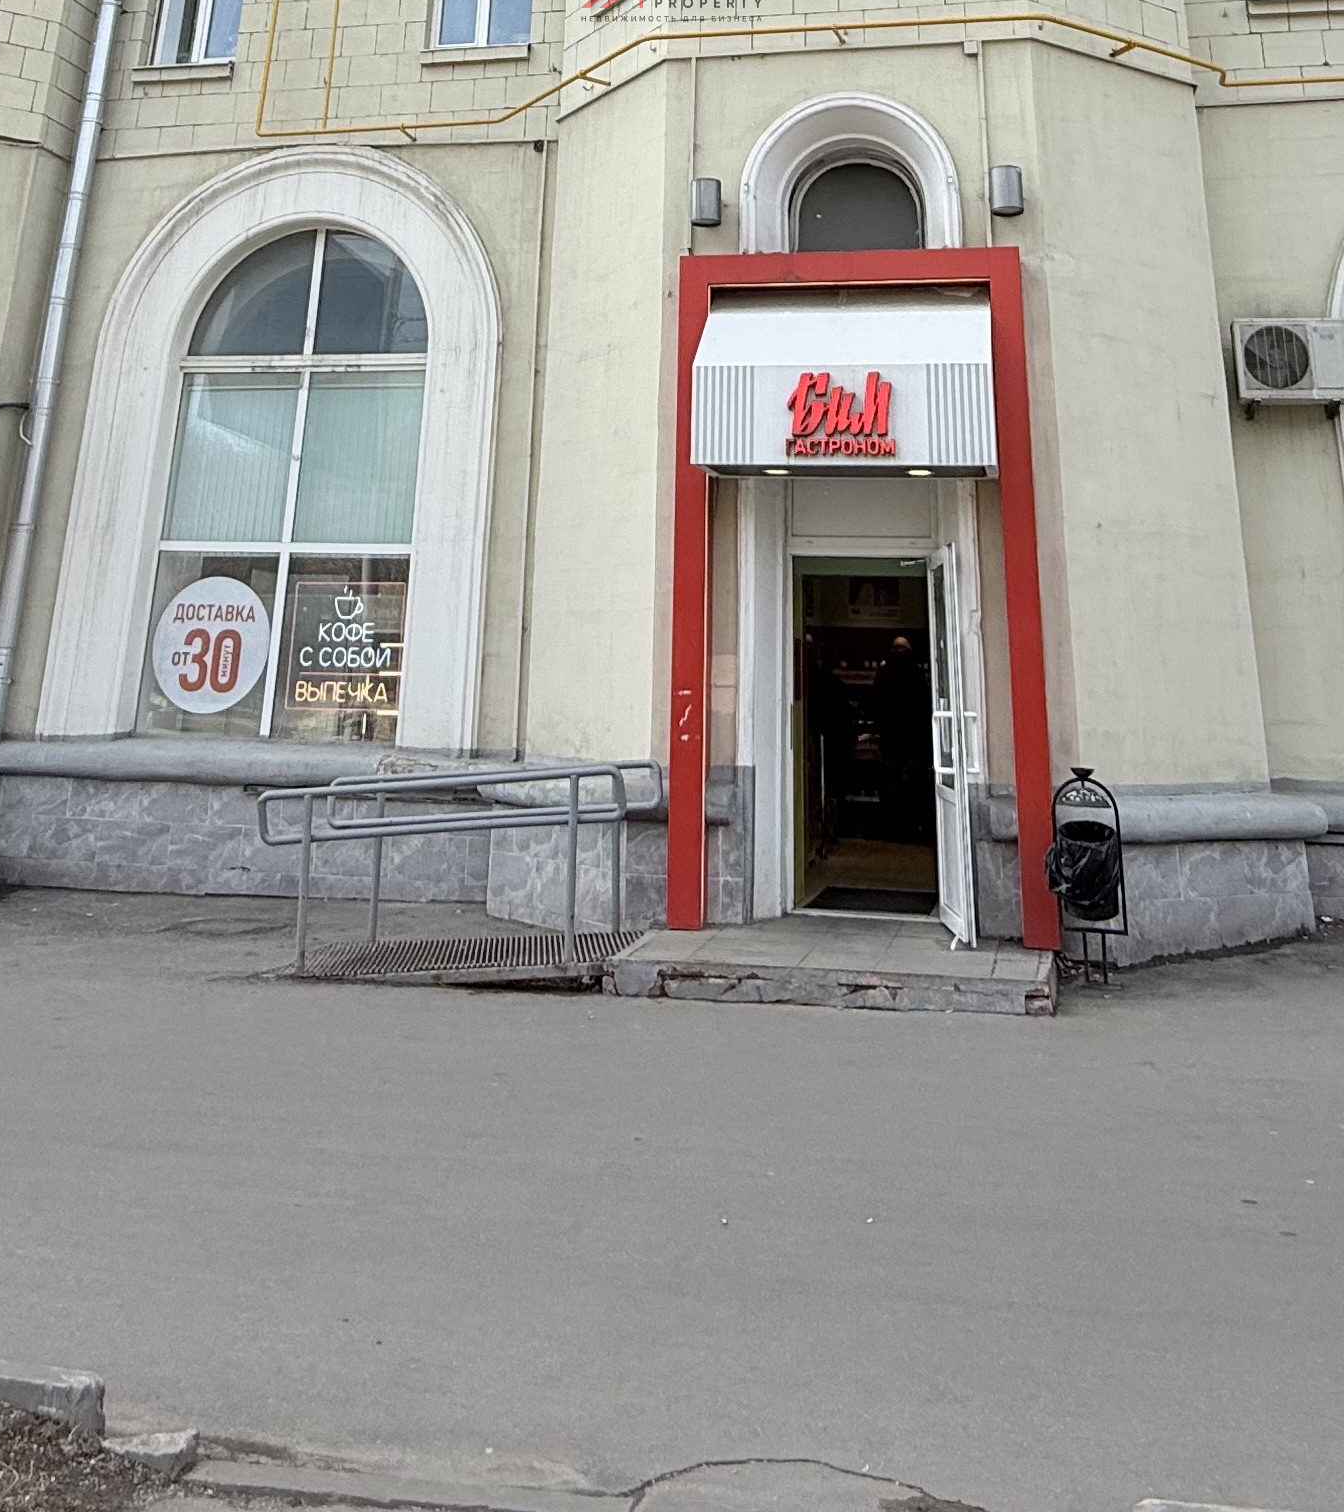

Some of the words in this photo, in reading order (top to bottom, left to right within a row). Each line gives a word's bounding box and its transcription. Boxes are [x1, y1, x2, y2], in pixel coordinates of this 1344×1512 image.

[785, 438, 896, 456] ГАСТРОНОМ
[172, 603, 256, 624] ДОСТАВКА
[318, 622, 375, 642] КОФЕ
[178, 628, 242, 693] 30
[299, 646, 314, 667] С
[295, 680, 388, 703] ВЫПЕЧКА
